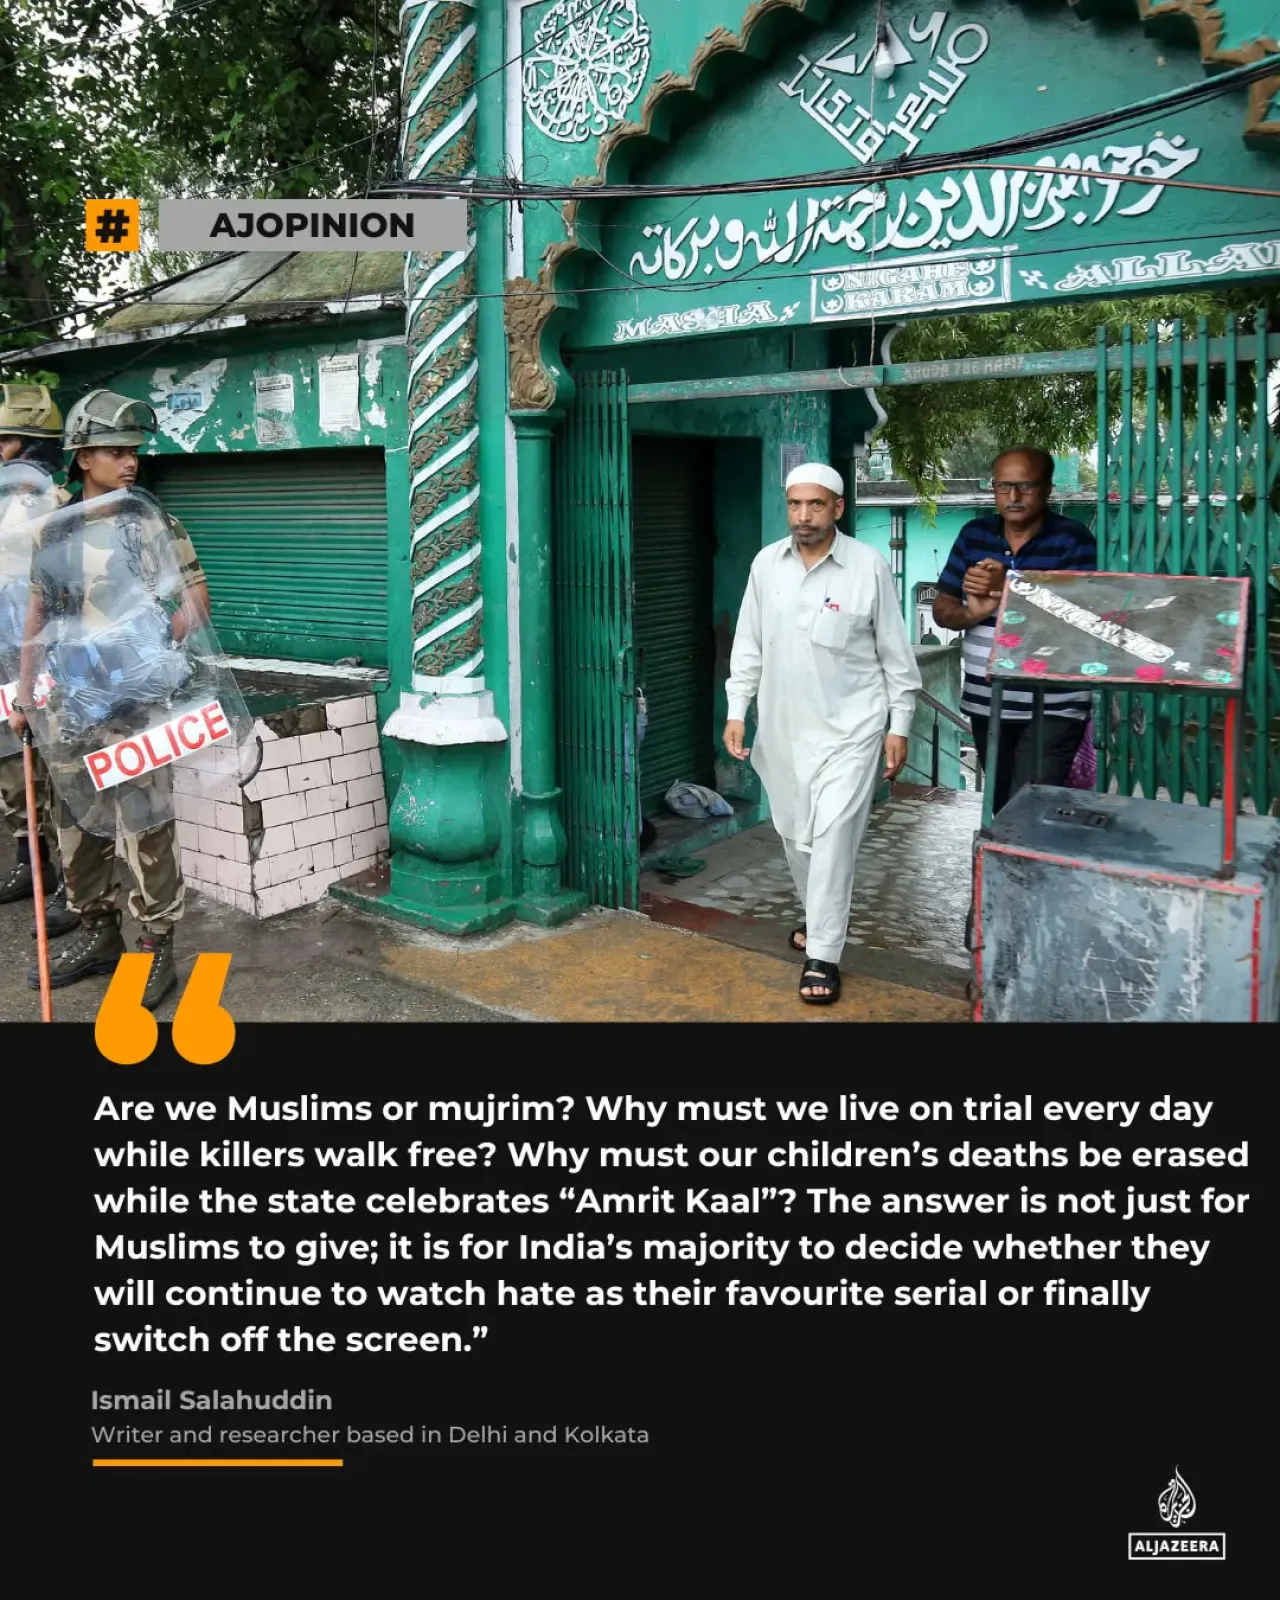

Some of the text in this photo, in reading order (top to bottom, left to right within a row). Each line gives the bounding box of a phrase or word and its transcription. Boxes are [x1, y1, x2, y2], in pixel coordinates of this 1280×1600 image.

[843, 260, 970, 291] NIGAHE
[843, 276, 970, 313] KARAM
[86, 703, 230, 789] POLICE
